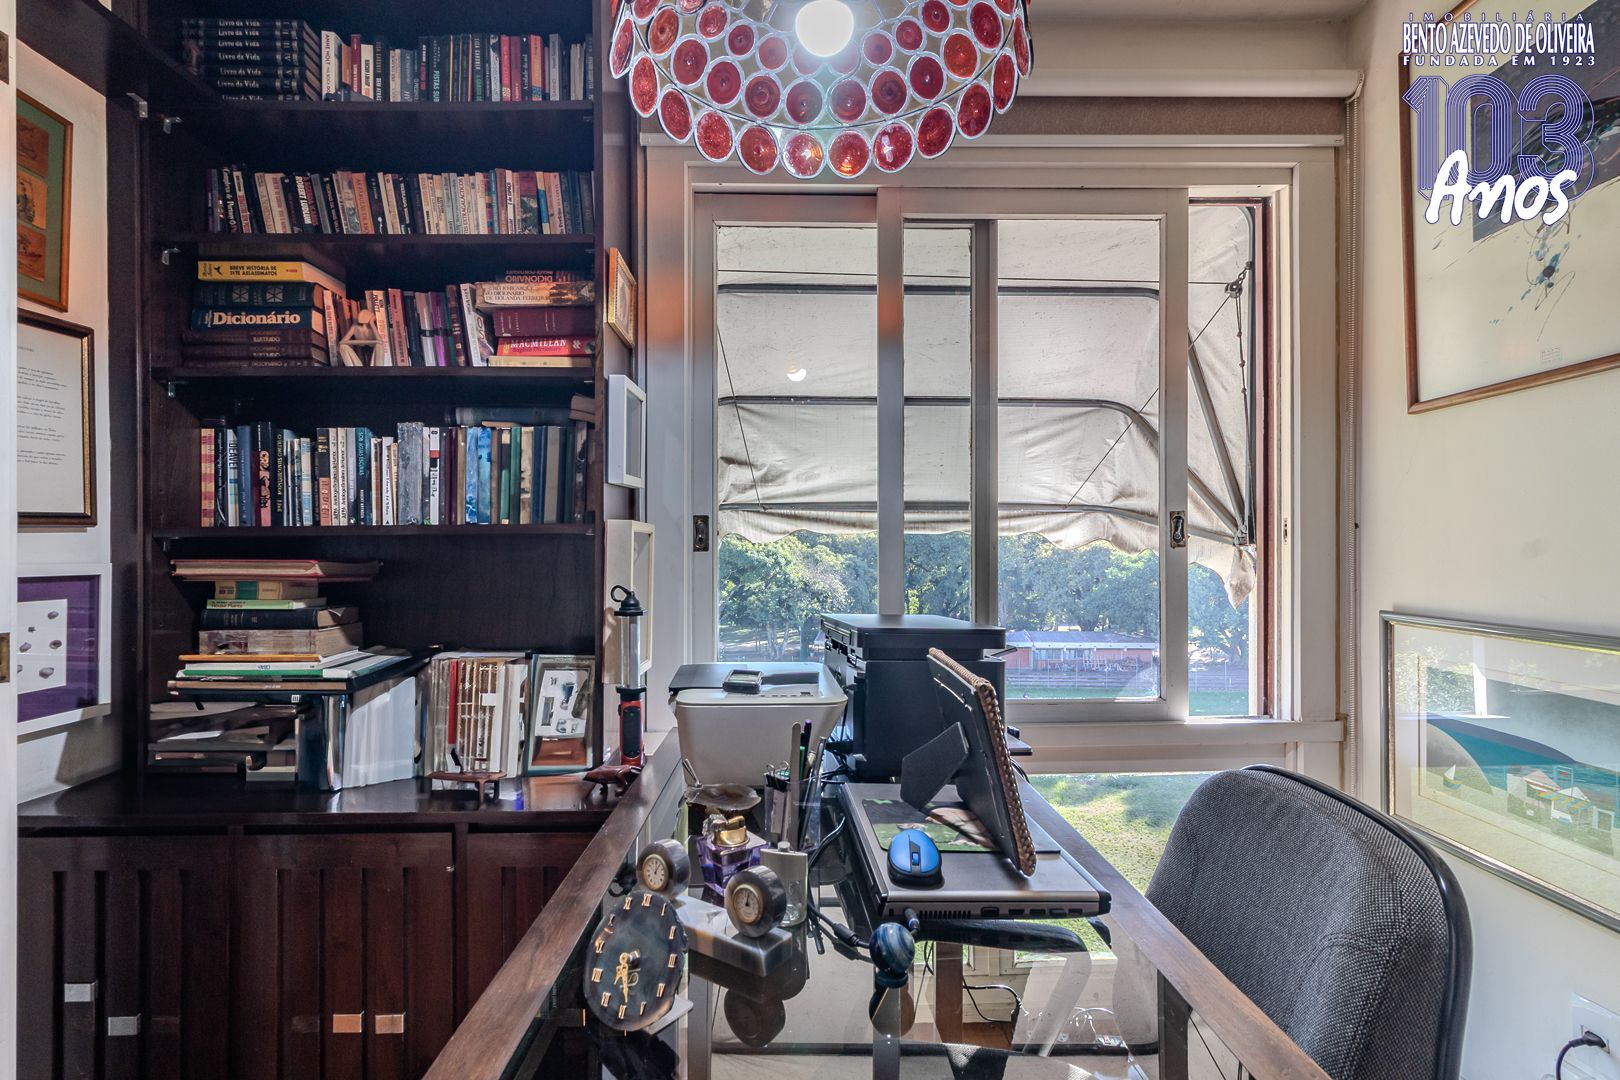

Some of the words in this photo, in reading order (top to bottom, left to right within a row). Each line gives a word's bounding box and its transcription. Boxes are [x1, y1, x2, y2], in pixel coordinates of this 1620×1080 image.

[220, 67, 236, 76] Livro
[238, 67, 245, 76] da
[247, 67, 261, 76] Vida
[218, 80, 234, 88] Livro
[236, 80, 243, 88] da
[245, 80, 259, 88] Vida
[295, 176, 306, 198] ROBERT
[300, 200, 311, 224] LUDLUM
[213, 311, 300, 324] Dicionário
[511, 338, 566, 348] MACMILLAN
[624, 897, 632, 910] XI
[642, 894, 652, 907] XII
[669, 925, 676, 939] II
[668, 953, 677, 968] III
[656, 983, 665, 997] IV
[618, 1005, 627, 1019] VI
